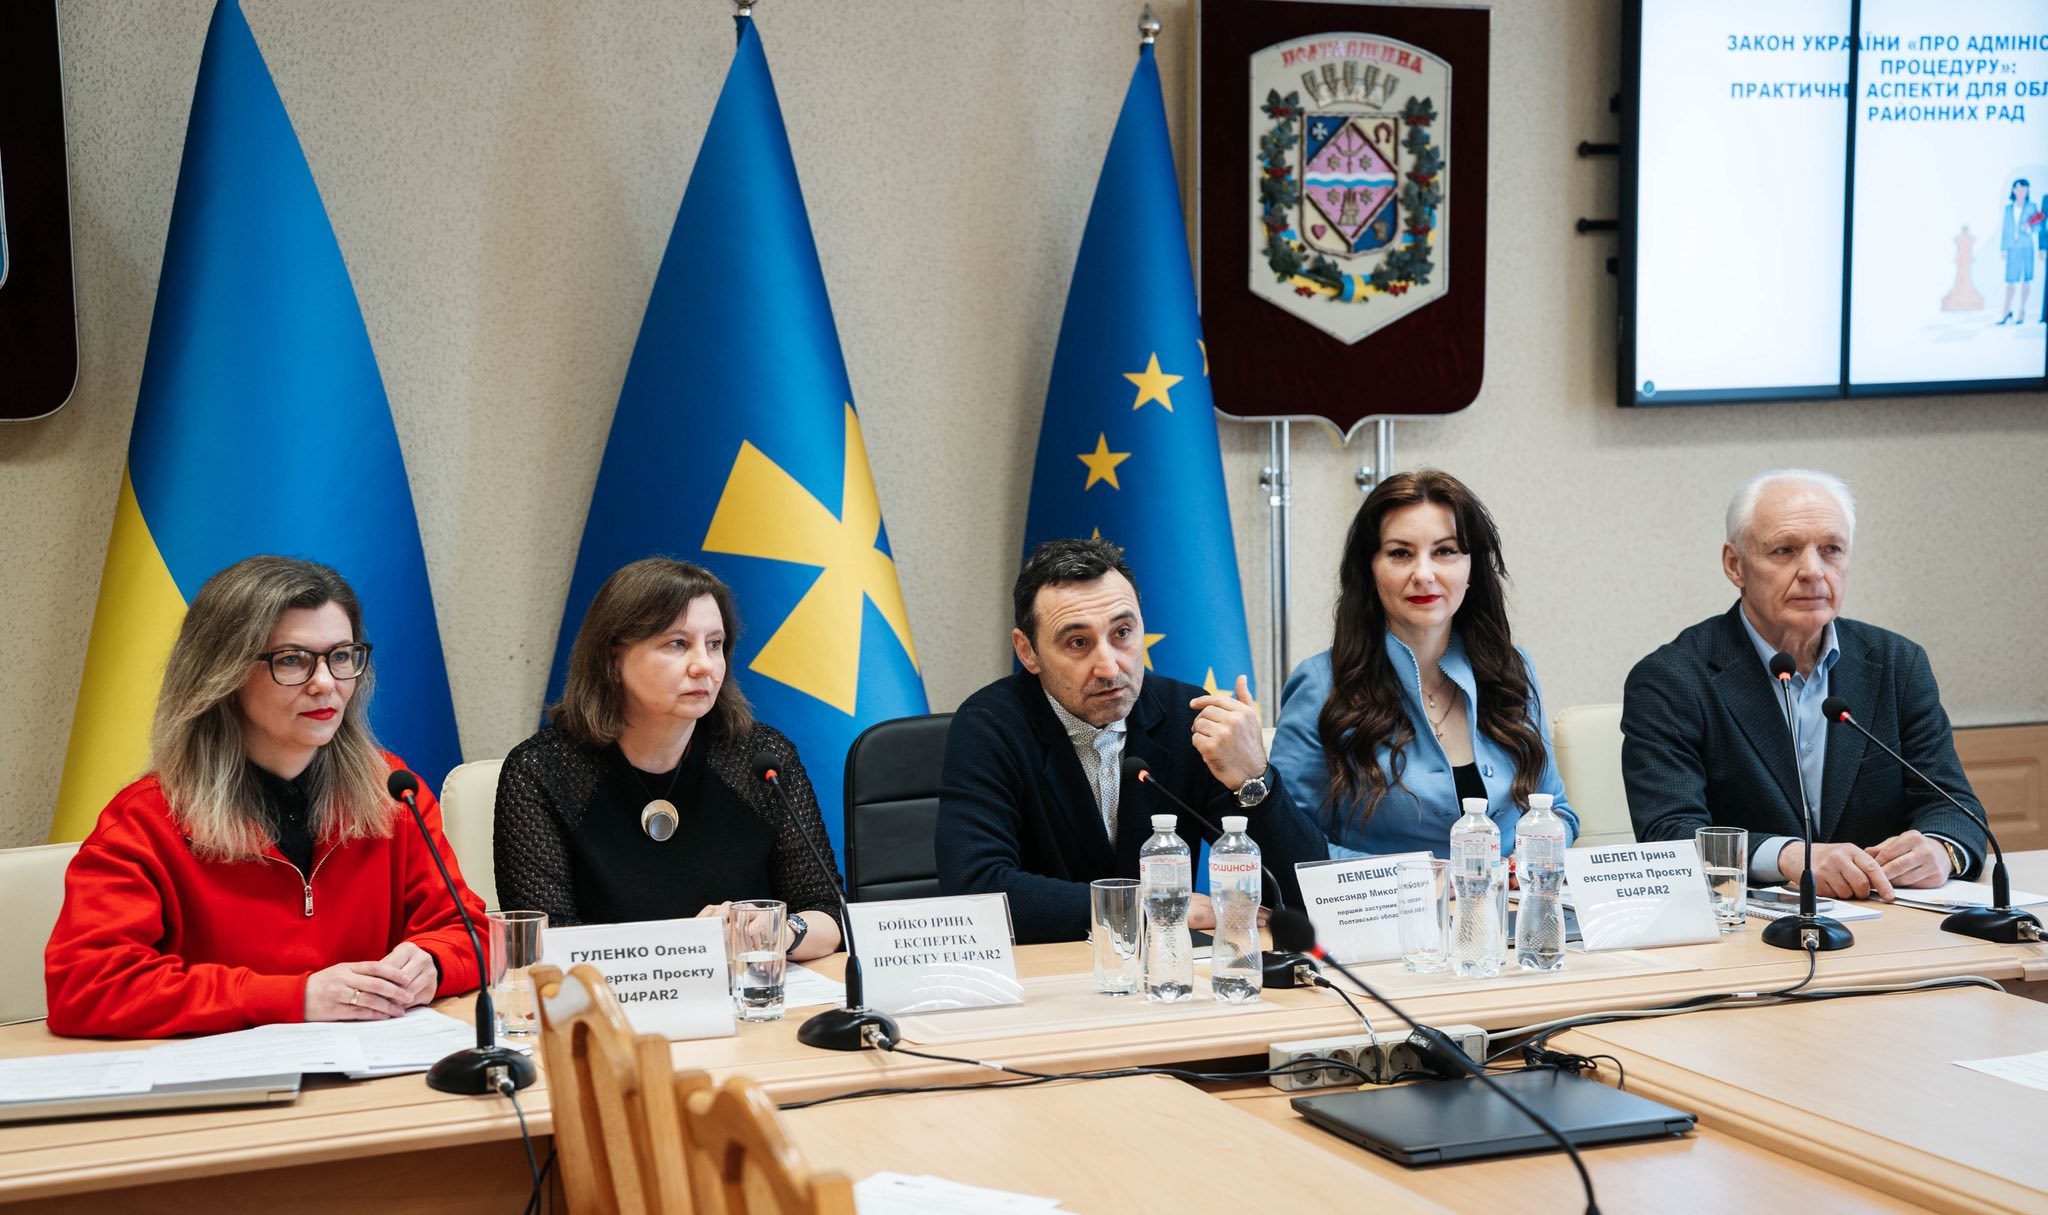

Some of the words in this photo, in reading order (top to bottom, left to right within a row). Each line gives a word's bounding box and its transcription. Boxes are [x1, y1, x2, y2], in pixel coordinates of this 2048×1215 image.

[1727, 34, 1795, 51] ЗАКОН
[1803, 32, 1900, 51] УКРАЇНИ
[1908, 35, 1959, 51] «ПРО
[1967, 34, 2048, 54] АДМІНІС
[1881, 59, 2017, 77] ПРОЦЕДУРУ»:
[1867, 82, 1959, 98] АСПЕКТИ
[1966, 82, 2007, 100] ДЛЯ
[1868, 103, 1979, 121] РАЙОННИХ
[1986, 105, 2025, 122] РАД
[1590, 851, 1638, 864] ШЕЛЕП
[1641, 850, 1676, 862] Ірина
[1583, 871, 1643, 884] експертка
[1646, 867, 1692, 879] Проєкту
[1315, 891, 1368, 905] Олександр
[1616, 884, 1670, 898] EU4PAR2
[1337, 906, 1363, 916] перший
[1364, 902, 1397, 913] заступник
[878, 916, 927, 932] БОЙКО
[931, 915, 974, 928] ІРИНА
[1339, 914, 1380, 926] Полтавської
[894, 934, 977, 949] ЕКСПЕРТКА
[571, 946, 649, 962] ГУЛЕНКО
[655, 945, 707, 957] Олена
[874, 954, 941, 969] ПРОЄКТУ
[944, 949, 1001, 963] EU4PAR2
[604, 972, 648, 985] ертка
[653, 967, 714, 981] Проєкту
[614, 988, 679, 1003] U4PAR2
